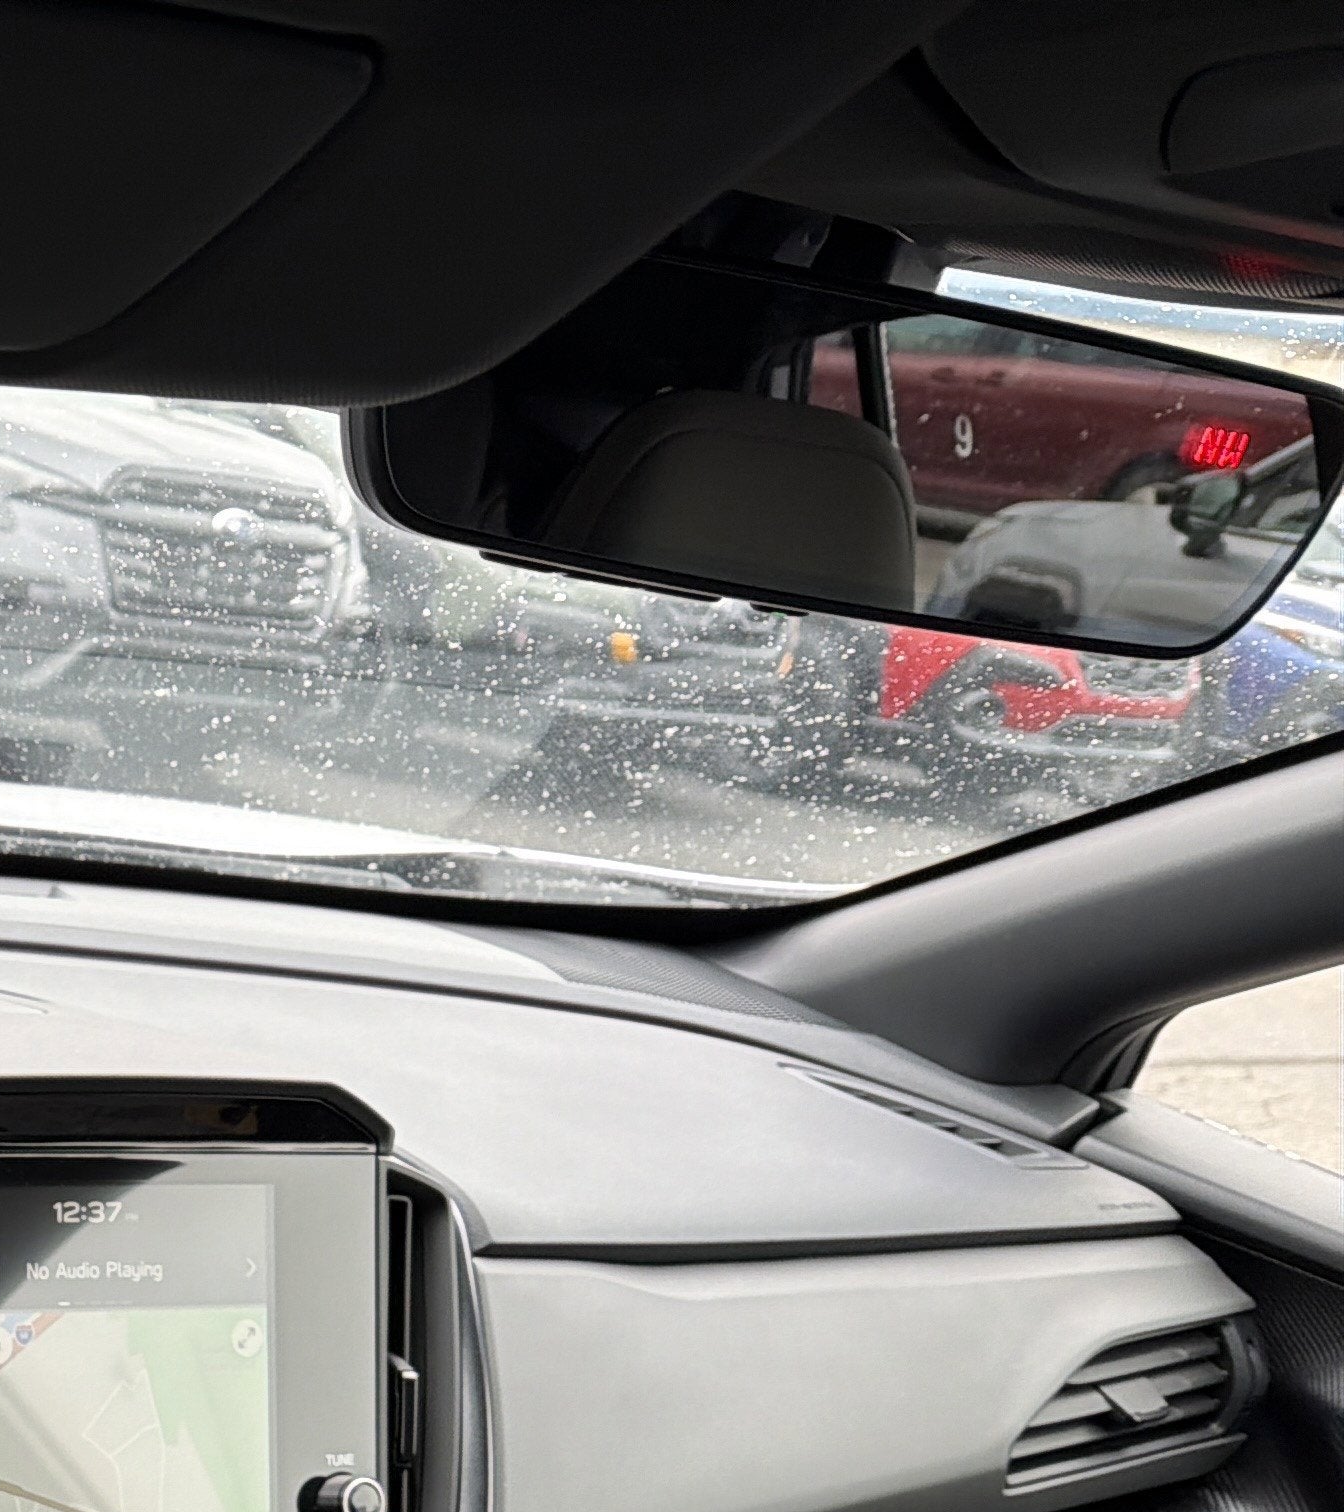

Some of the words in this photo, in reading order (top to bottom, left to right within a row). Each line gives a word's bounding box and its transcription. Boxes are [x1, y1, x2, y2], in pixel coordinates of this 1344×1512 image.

[53, 1201, 123, 1224] 12:37
[26, 1263, 49, 1280] No
[55, 1262, 100, 1280] Audio
[106, 1261, 163, 1281] Playing
[325, 1454, 354, 1466] TUNE
